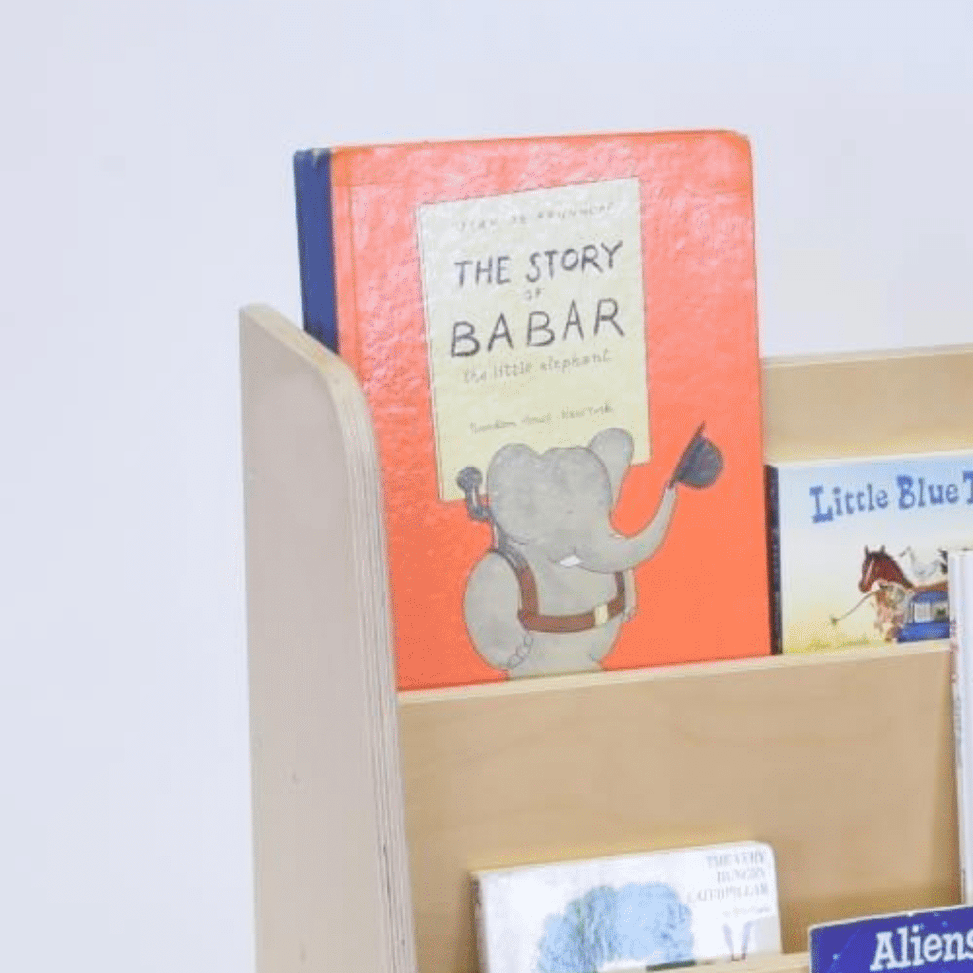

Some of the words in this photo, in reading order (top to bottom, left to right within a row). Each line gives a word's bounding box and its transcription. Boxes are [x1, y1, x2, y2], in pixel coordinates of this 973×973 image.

[453, 255, 512, 288] THE
[525, 240, 624, 284] STORY
[450, 297, 626, 358] BABAR
[809, 483, 889, 524] Little
[896, 473, 960, 511] Blue
